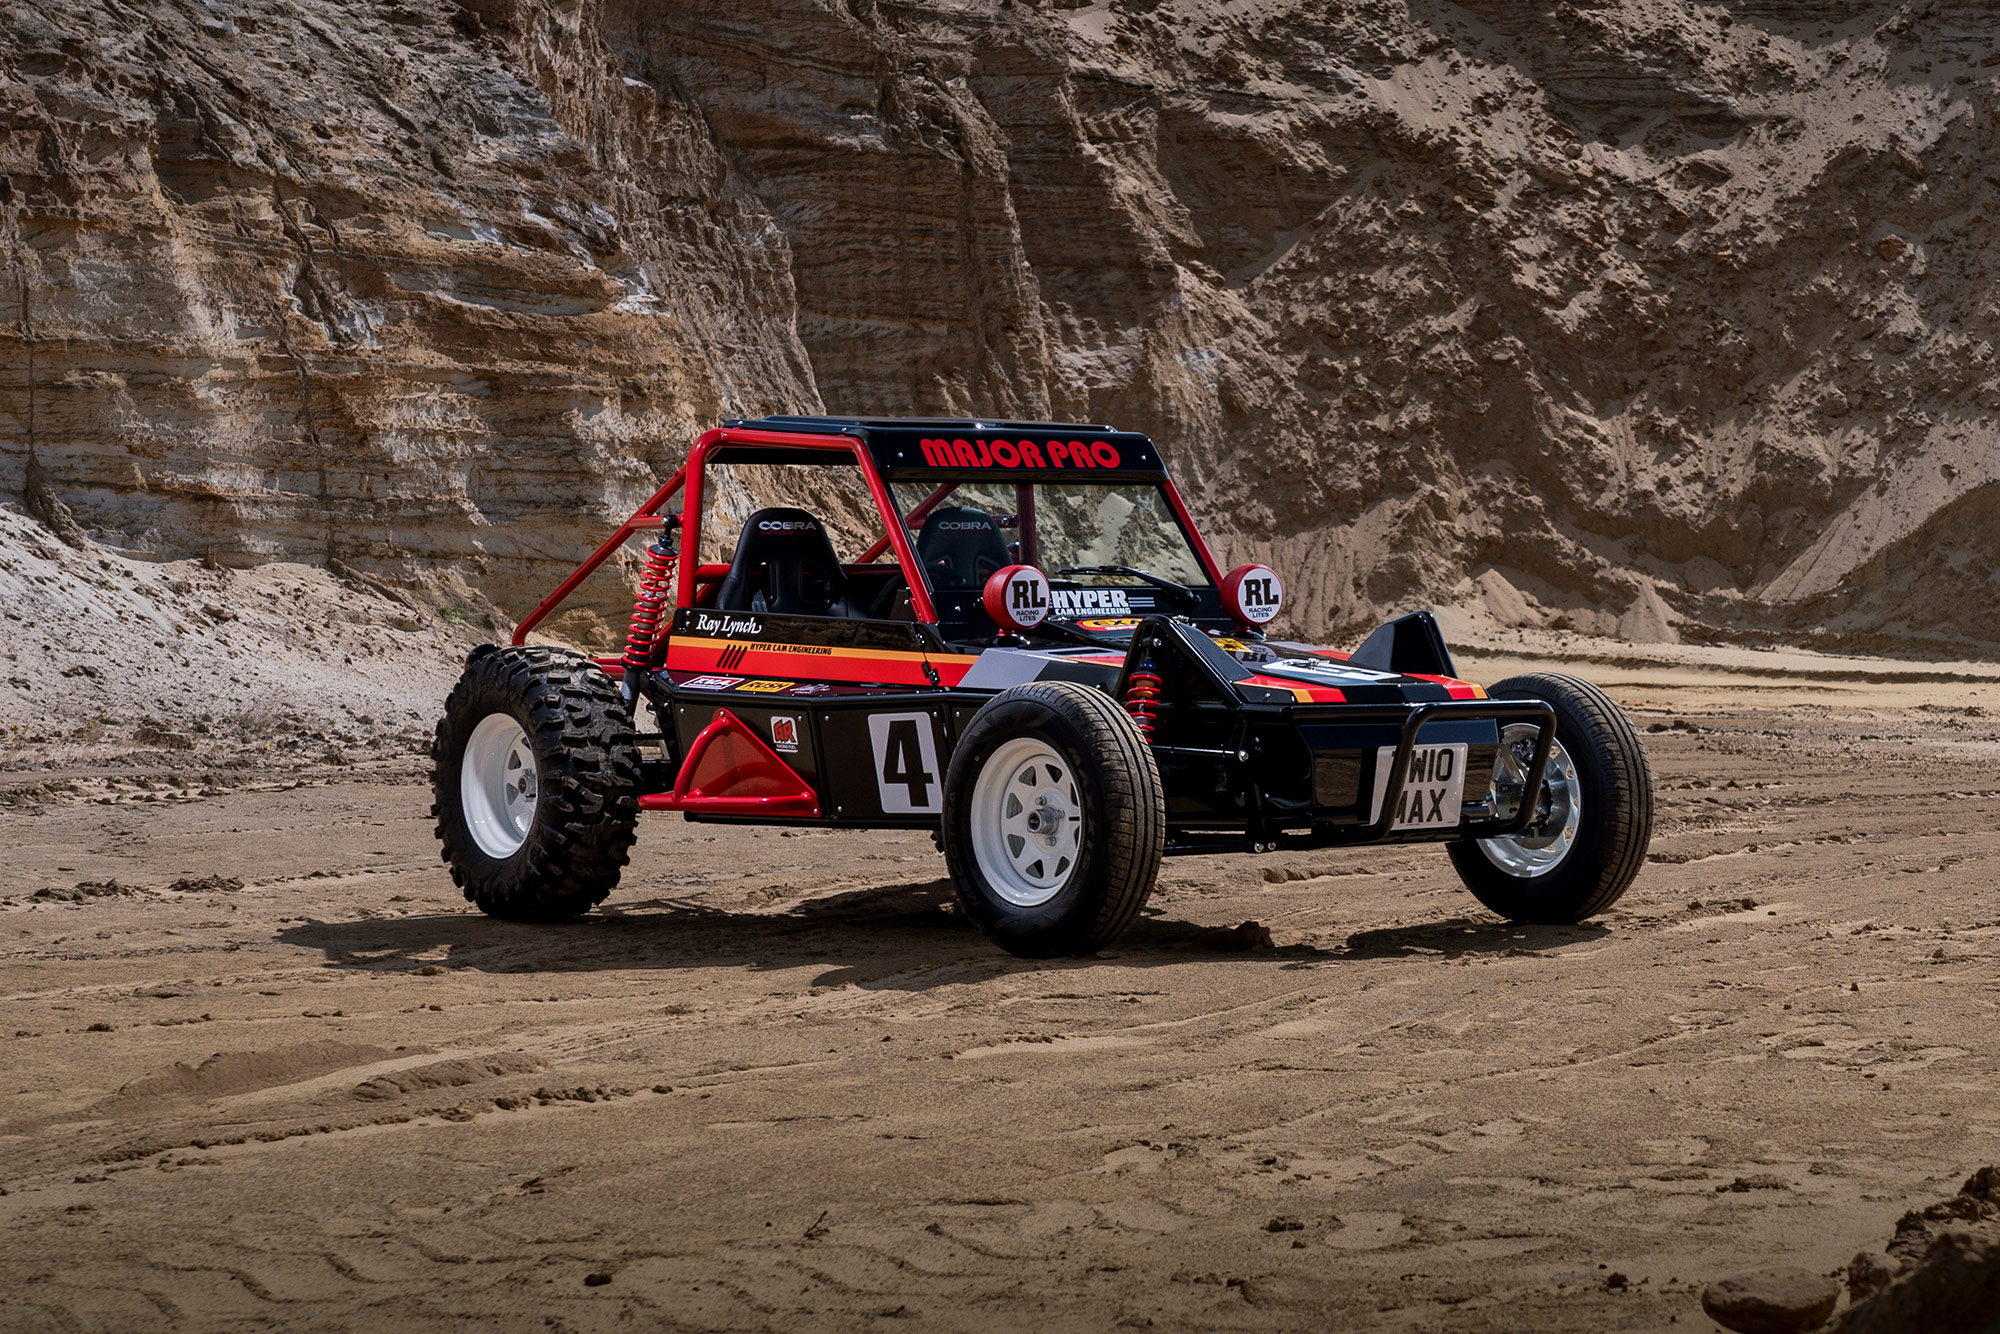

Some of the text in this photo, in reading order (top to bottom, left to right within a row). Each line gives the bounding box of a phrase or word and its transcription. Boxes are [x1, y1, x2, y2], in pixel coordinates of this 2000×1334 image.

[920, 438, 1121, 469] MAJOR PRO
[758, 520, 817, 531] COBRA
[938, 521, 992, 531] COBRA
[1012, 580, 1046, 609] RL
[1051, 590, 1129, 608] HYPER
[1244, 578, 1279, 607] RL
[1055, 607, 1132, 615] CAM ENGINEERING
[696, 614, 762, 637] Ray Lynch
[750, 643, 832, 655] HYPER CAM ENGINEERING
[774, 719, 797, 743] GR
[883, 719, 934, 807] 4
[1392, 748, 1454, 783] W10
